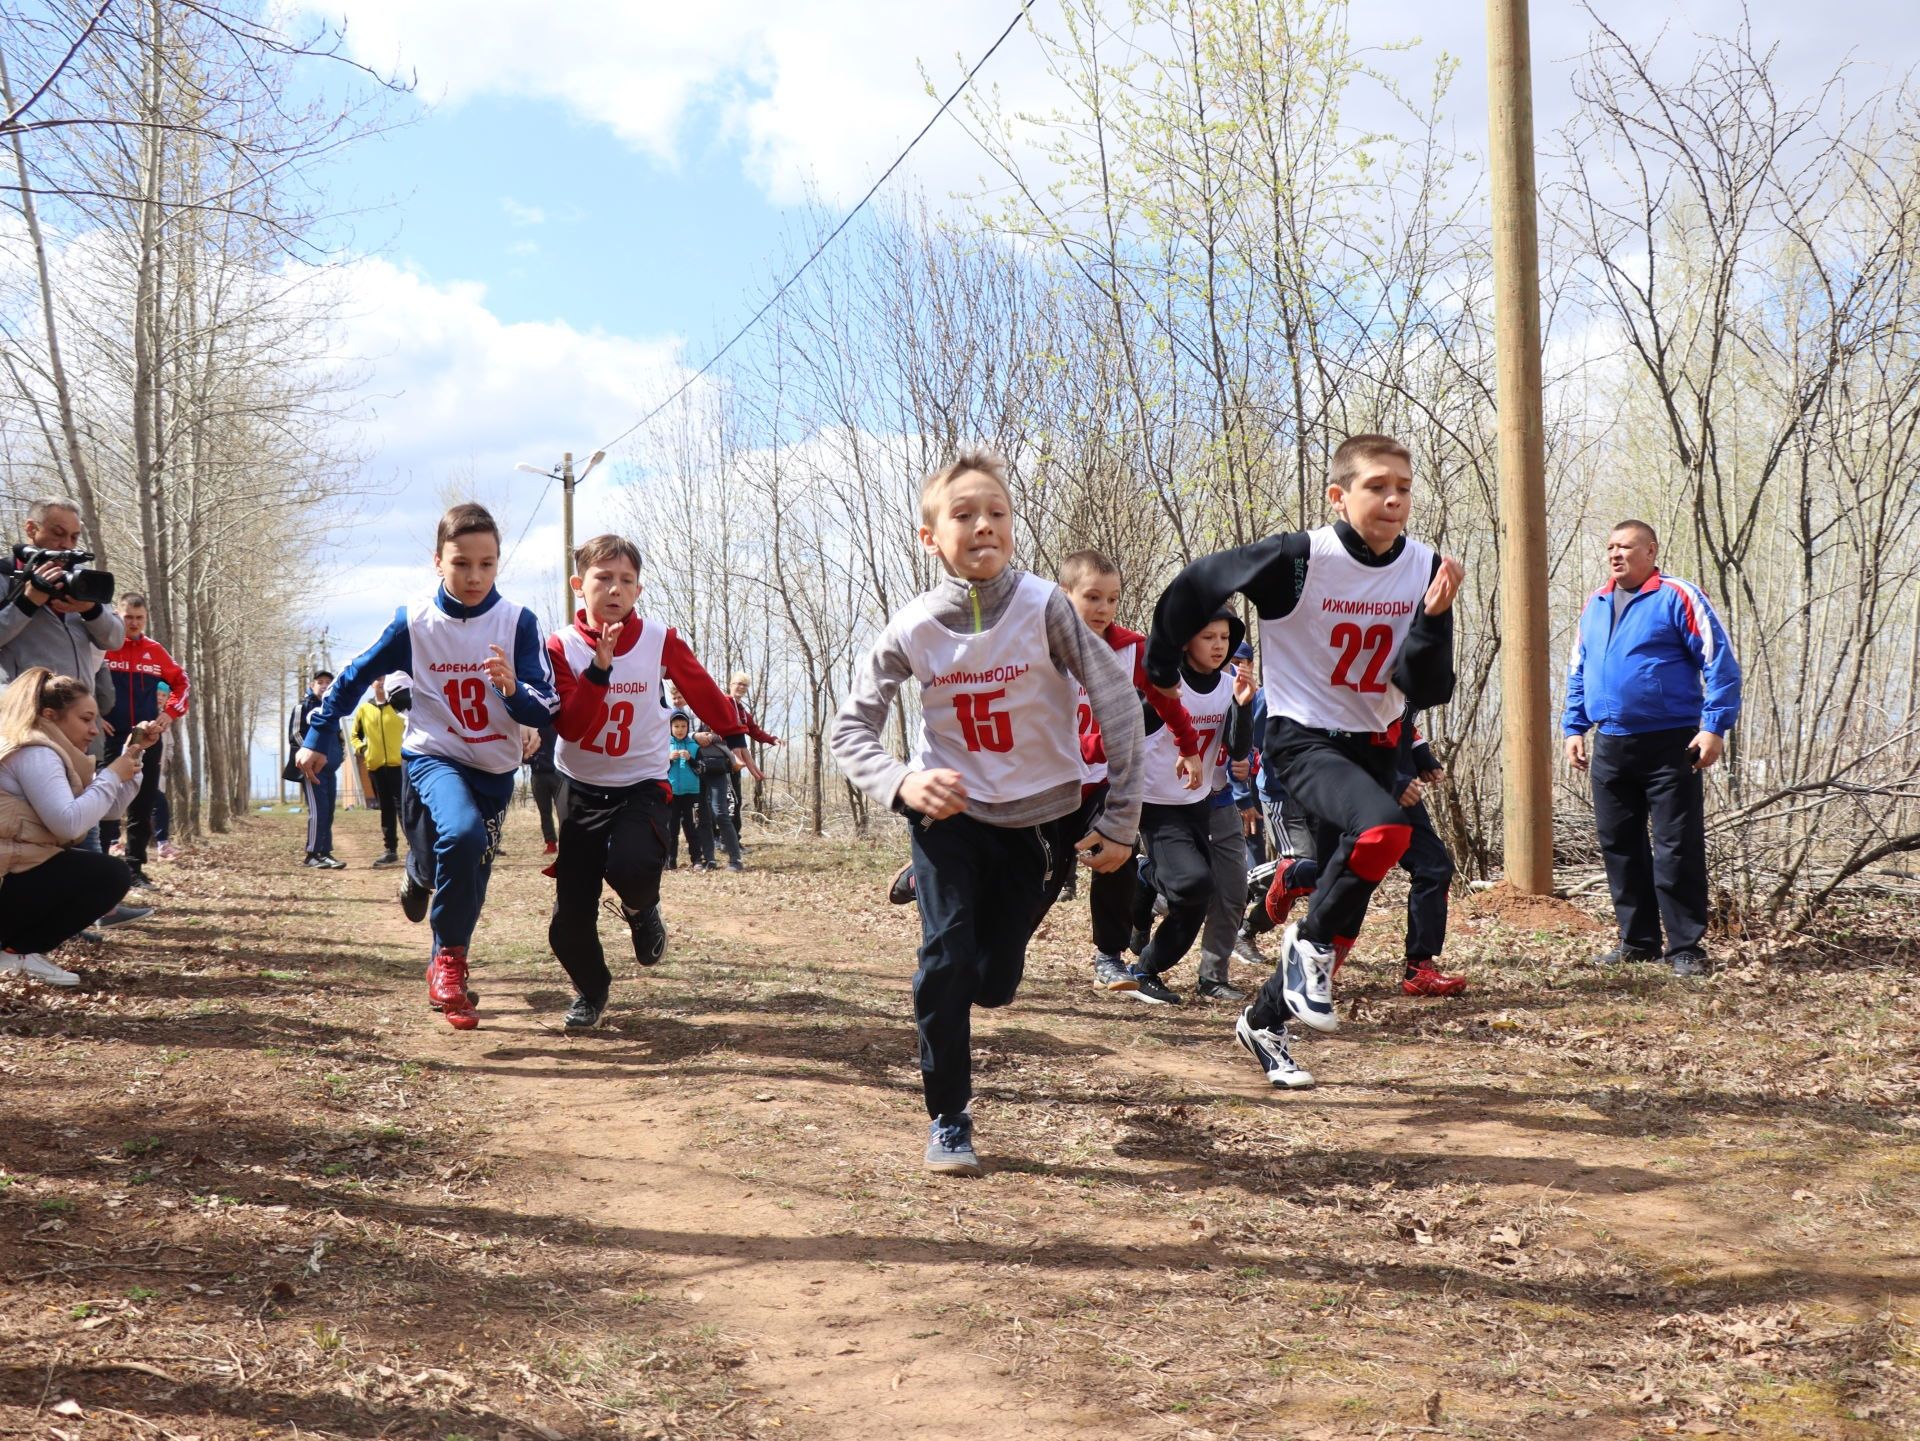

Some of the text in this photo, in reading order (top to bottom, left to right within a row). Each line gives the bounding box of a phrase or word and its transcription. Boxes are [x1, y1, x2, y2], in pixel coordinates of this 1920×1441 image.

[1322, 598, 1413, 617] ИЖМИНВОДЫ
[429, 662, 486, 673] АДРЕНАЛ
[1330, 622, 1393, 693] 22
[444, 677, 489, 731] 13
[608, 682, 648, 694] НВОДЫ
[580, 701, 634, 757] 23
[952, 688, 1014, 753] 15
